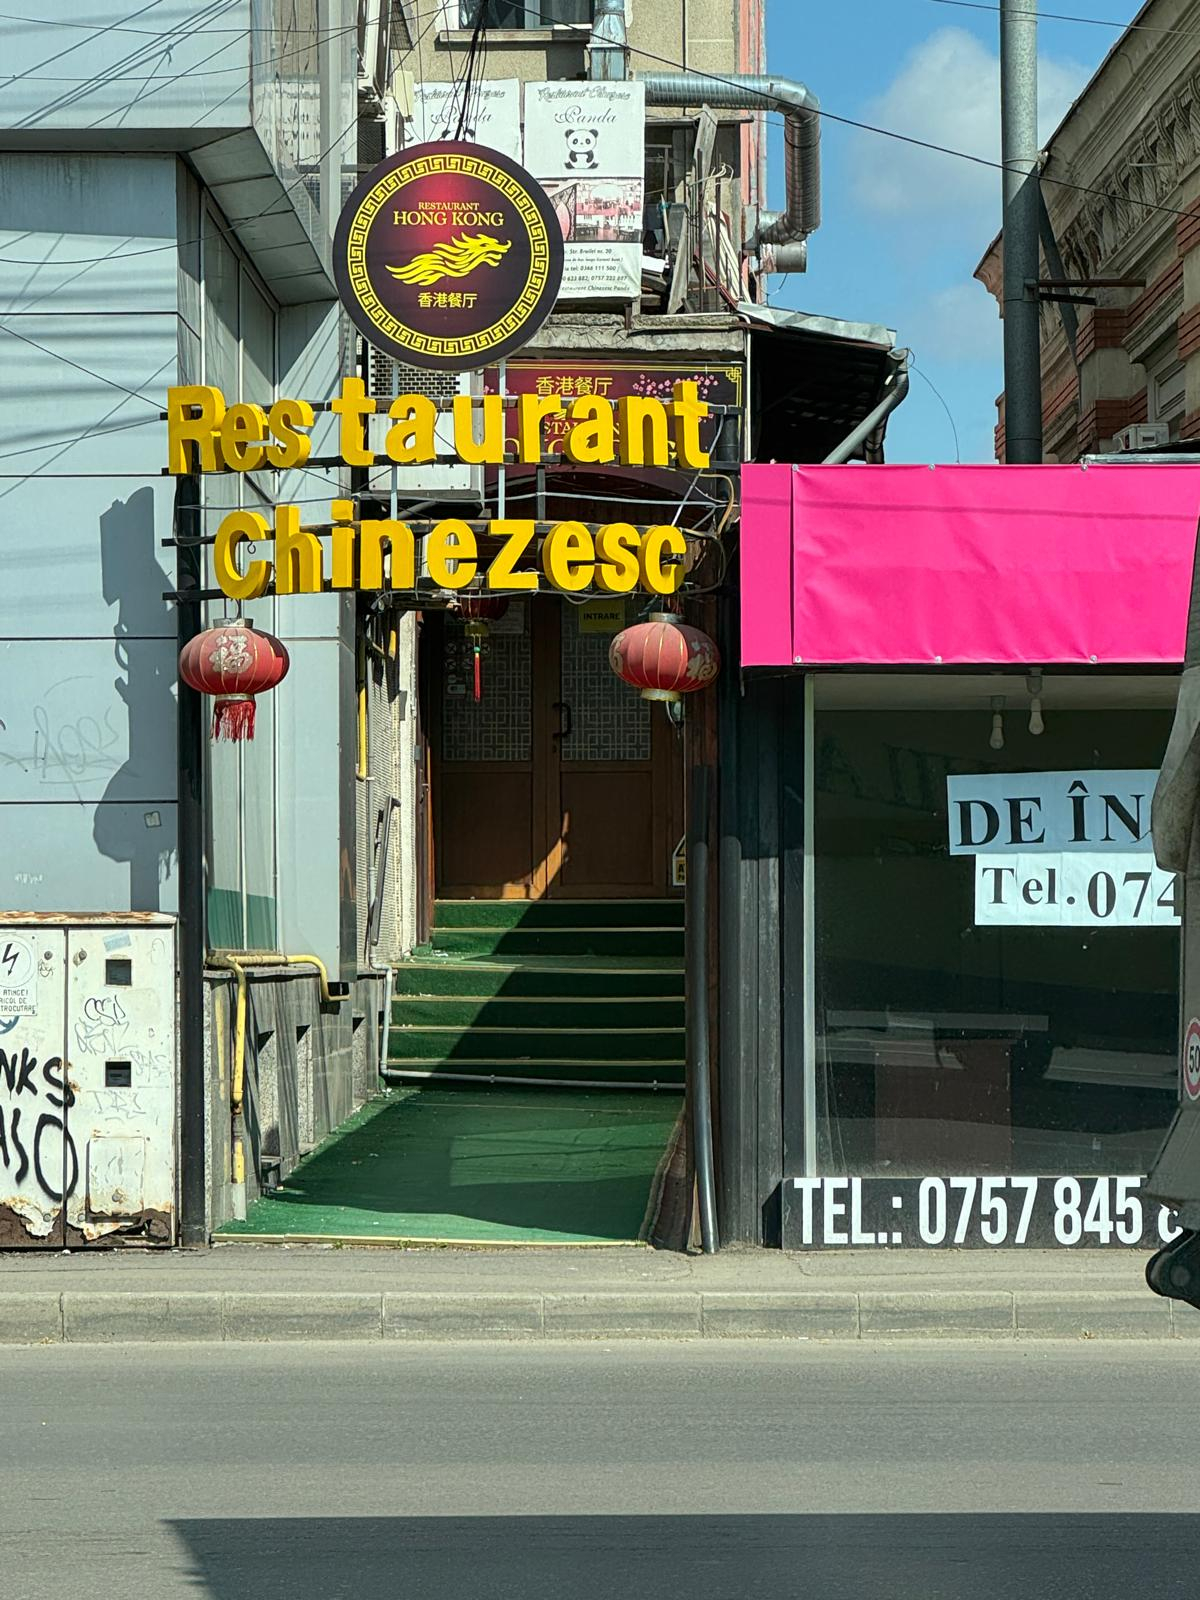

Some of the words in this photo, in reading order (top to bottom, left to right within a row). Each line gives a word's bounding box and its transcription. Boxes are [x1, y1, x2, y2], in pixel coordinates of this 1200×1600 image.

[554, 105, 617, 124] Panda
[418, 202, 480, 211] RESTAURANT
[393, 211, 448, 226] HONG
[452, 212, 504, 227] KONG
[417, 291, 478, 309] 香港餐厅
[535, 375, 613, 396] 香港餐厅
[167, 376, 711, 475] Restaurant
[213, 499, 687, 600] Chinezesc
[583, 612, 620, 621] INTRARE
[953, 796, 1046, 847] DE
[1066, 780, 1146, 843] ÎN
[793, 1176, 902, 1245] TEL.:
[918, 1176, 1039, 1245] 0757
[1053, 1176, 1143, 1245] 845
